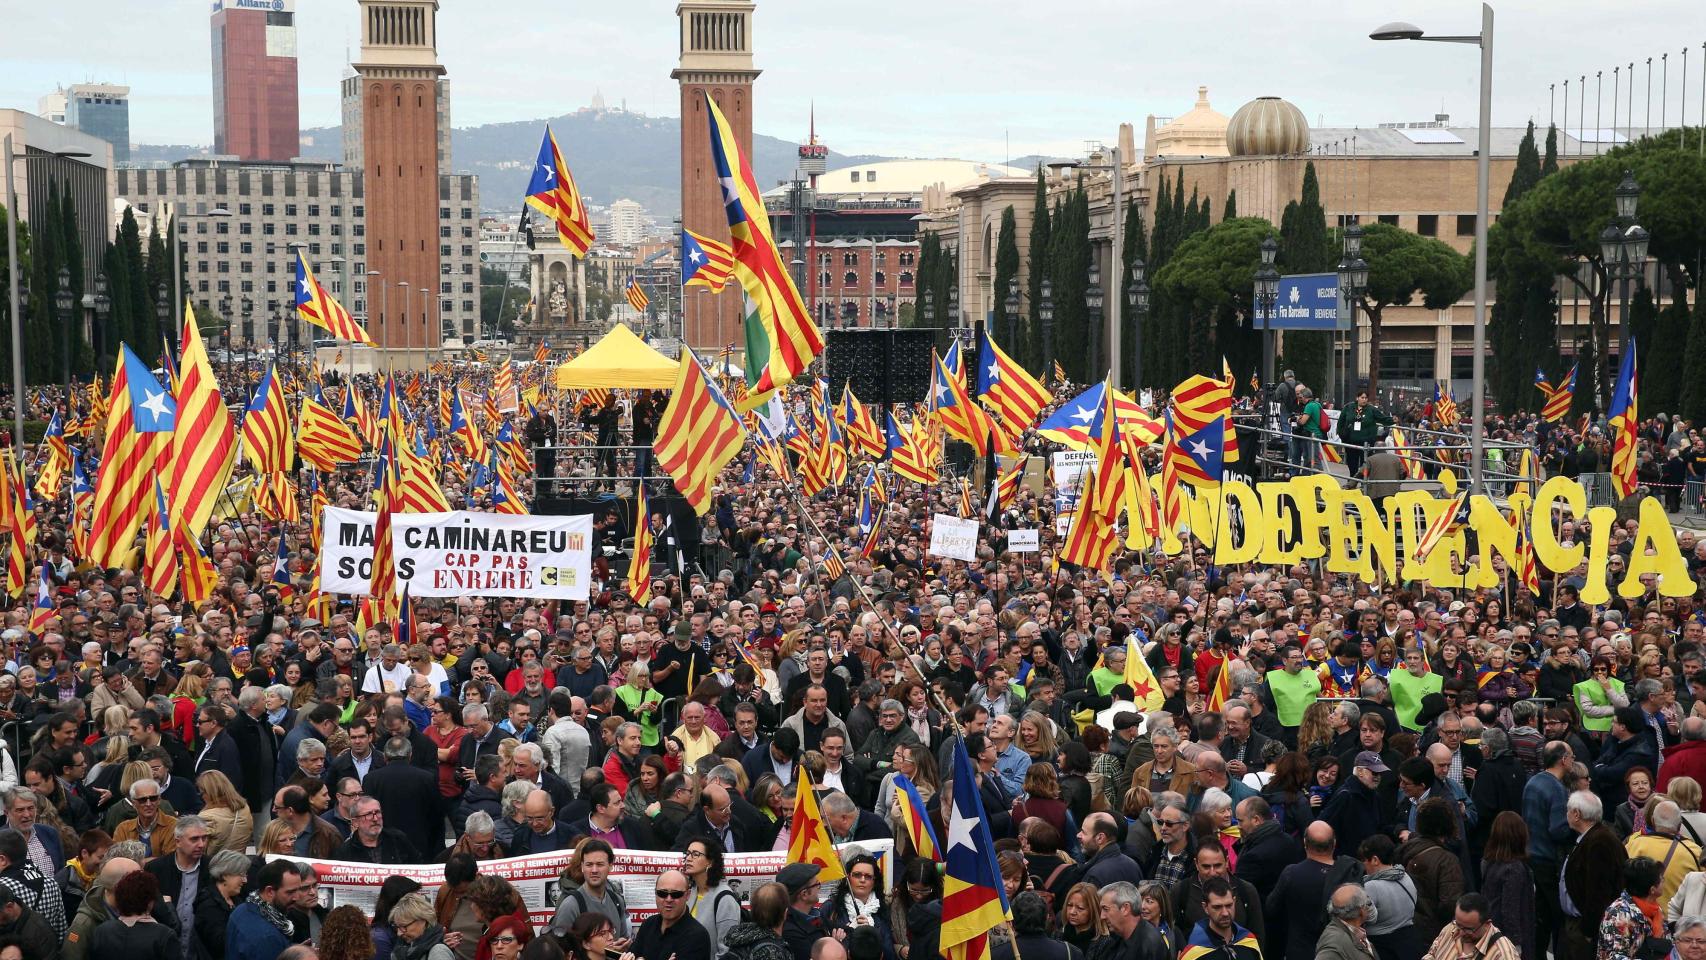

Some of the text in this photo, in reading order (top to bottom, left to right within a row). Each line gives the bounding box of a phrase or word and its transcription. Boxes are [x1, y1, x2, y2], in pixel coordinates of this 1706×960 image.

[1317, 287, 1337, 299] WELCOME
[1279, 304, 1287, 318] Fira
[1288, 304, 1310, 318] Barcelona
[339, 522, 375, 547] MA
[337, 556, 416, 580] SOS
[445, 552, 528, 570] CAP PAS
[433, 569, 533, 590] ENRERE
[331, 866, 375, 875] CATALUNYA
[401, 868, 416, 876] CAP
[495, 863, 510, 871] CAL
[511, 861, 526, 869] SER
[526, 856, 572, 868] REINVENTA
[613, 856, 631, 864] ACIÓ
[363, 875, 379, 885] QUE
[513, 869, 524, 878] DE
[524, 867, 554, 878] SEMPRE
[628, 865, 643, 873] QUE
[736, 865, 756, 874] TOTA
[757, 864, 779, 873] MENA
